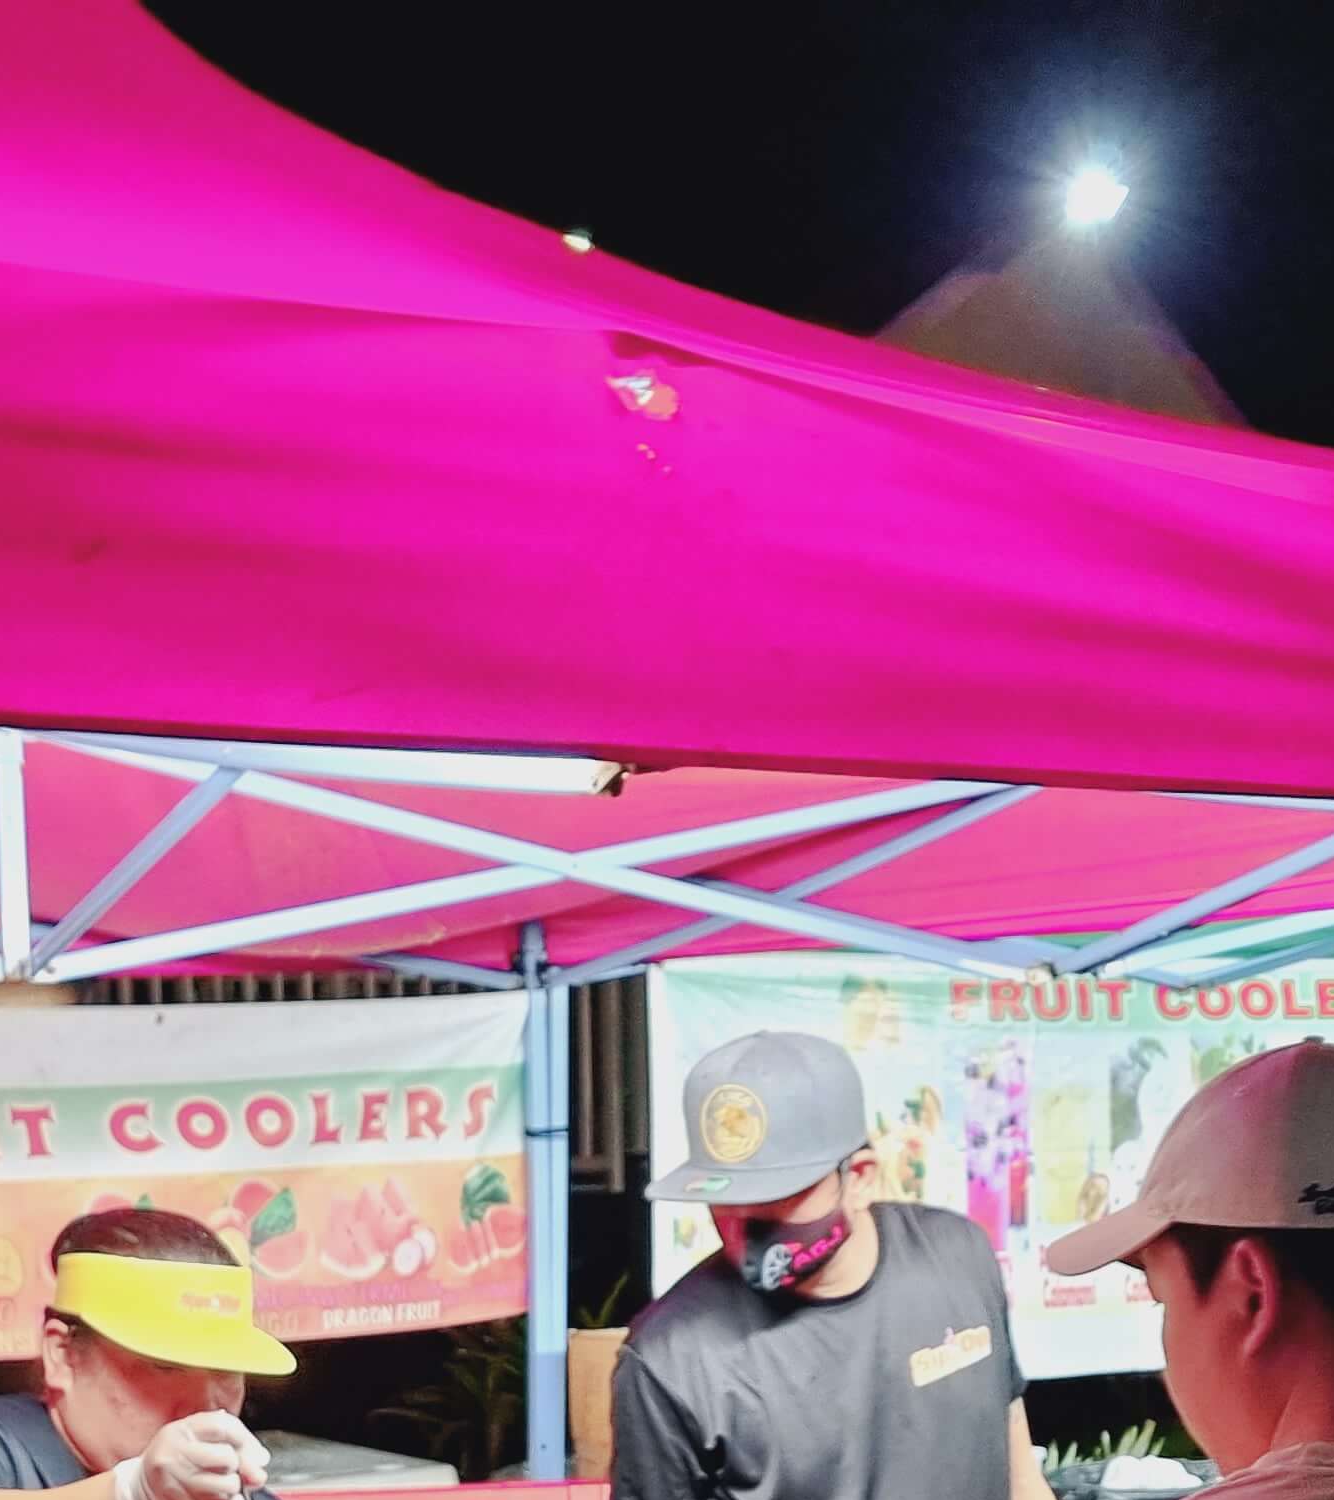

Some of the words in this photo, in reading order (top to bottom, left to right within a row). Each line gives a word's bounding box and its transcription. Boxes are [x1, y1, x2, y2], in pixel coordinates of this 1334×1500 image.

[948, 976, 1134, 1021] FRUIT
[107, 1083, 498, 1154] COOLERS
[322, 1304, 395, 1331] DRAGON
[397, 1299, 442, 1322] FRUIT
